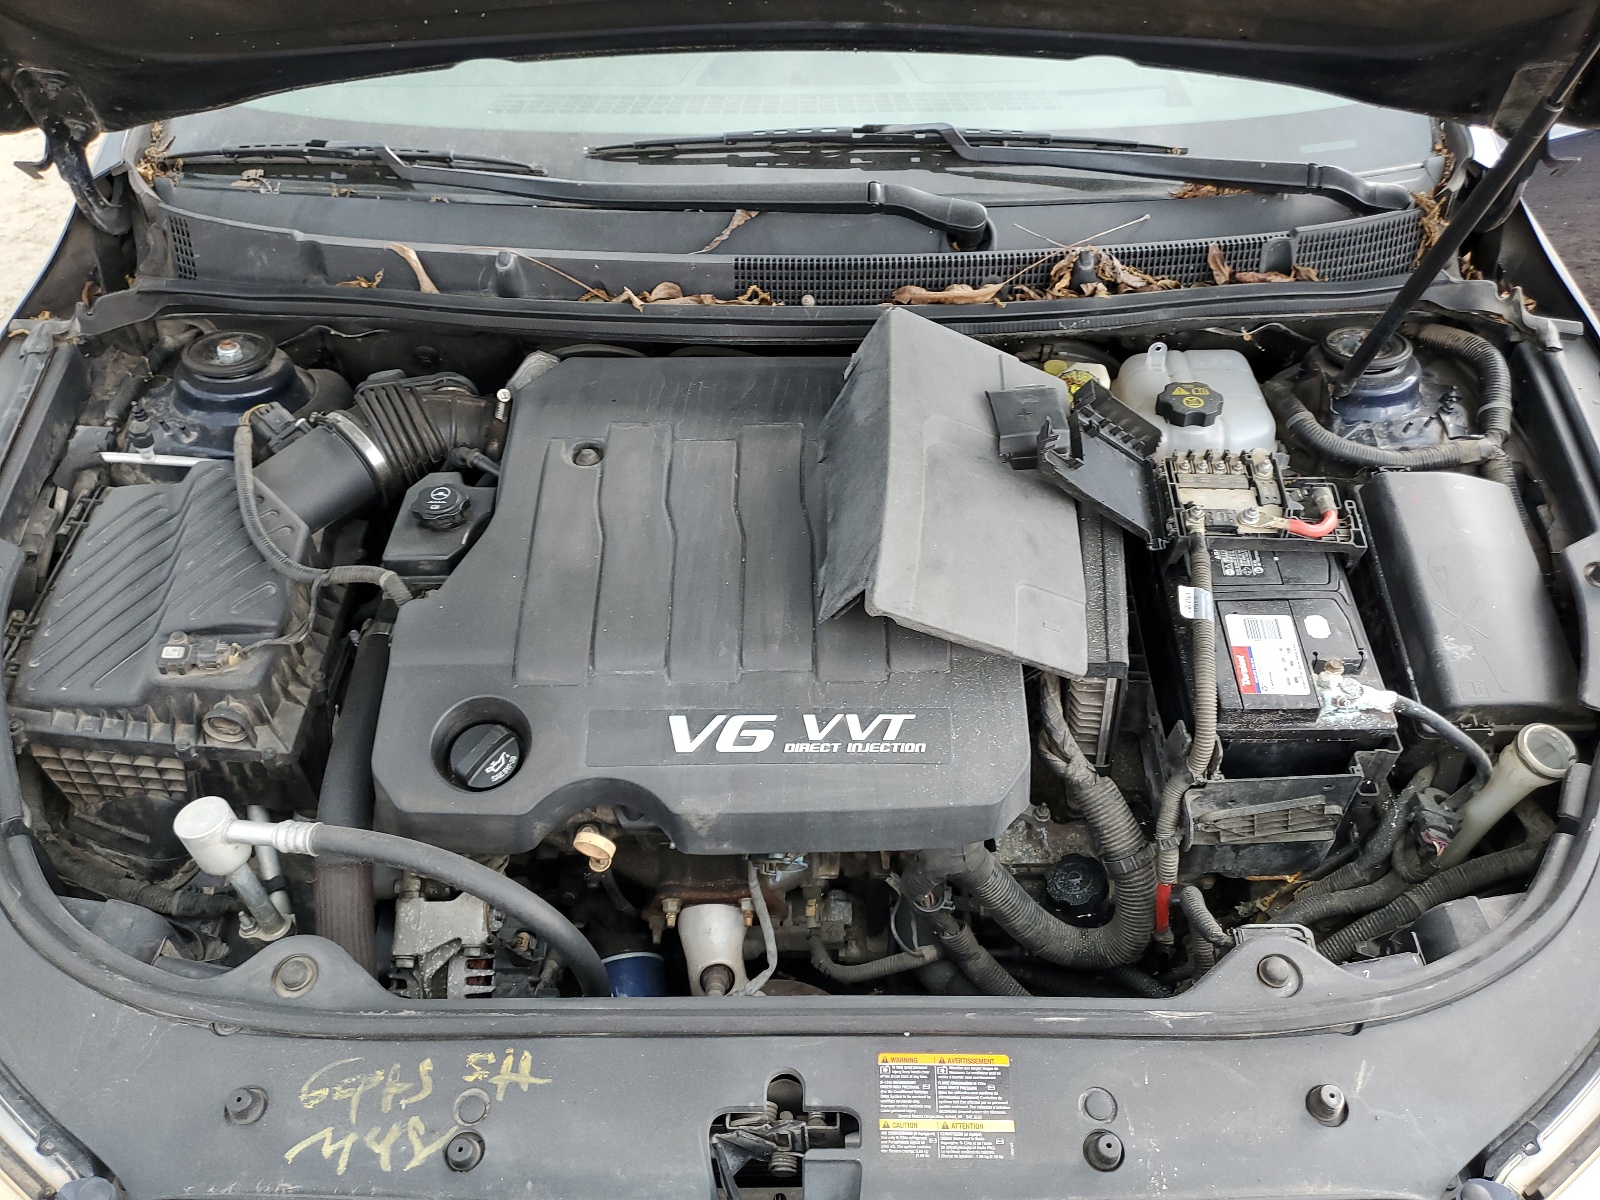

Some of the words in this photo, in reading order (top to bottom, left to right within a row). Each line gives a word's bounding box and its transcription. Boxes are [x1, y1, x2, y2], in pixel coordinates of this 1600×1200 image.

[668, 714, 778, 753] V6
[802, 713, 917, 741] VVT
[783, 742, 842, 753] DIRECT
[846, 742, 927, 753] INJECTION
